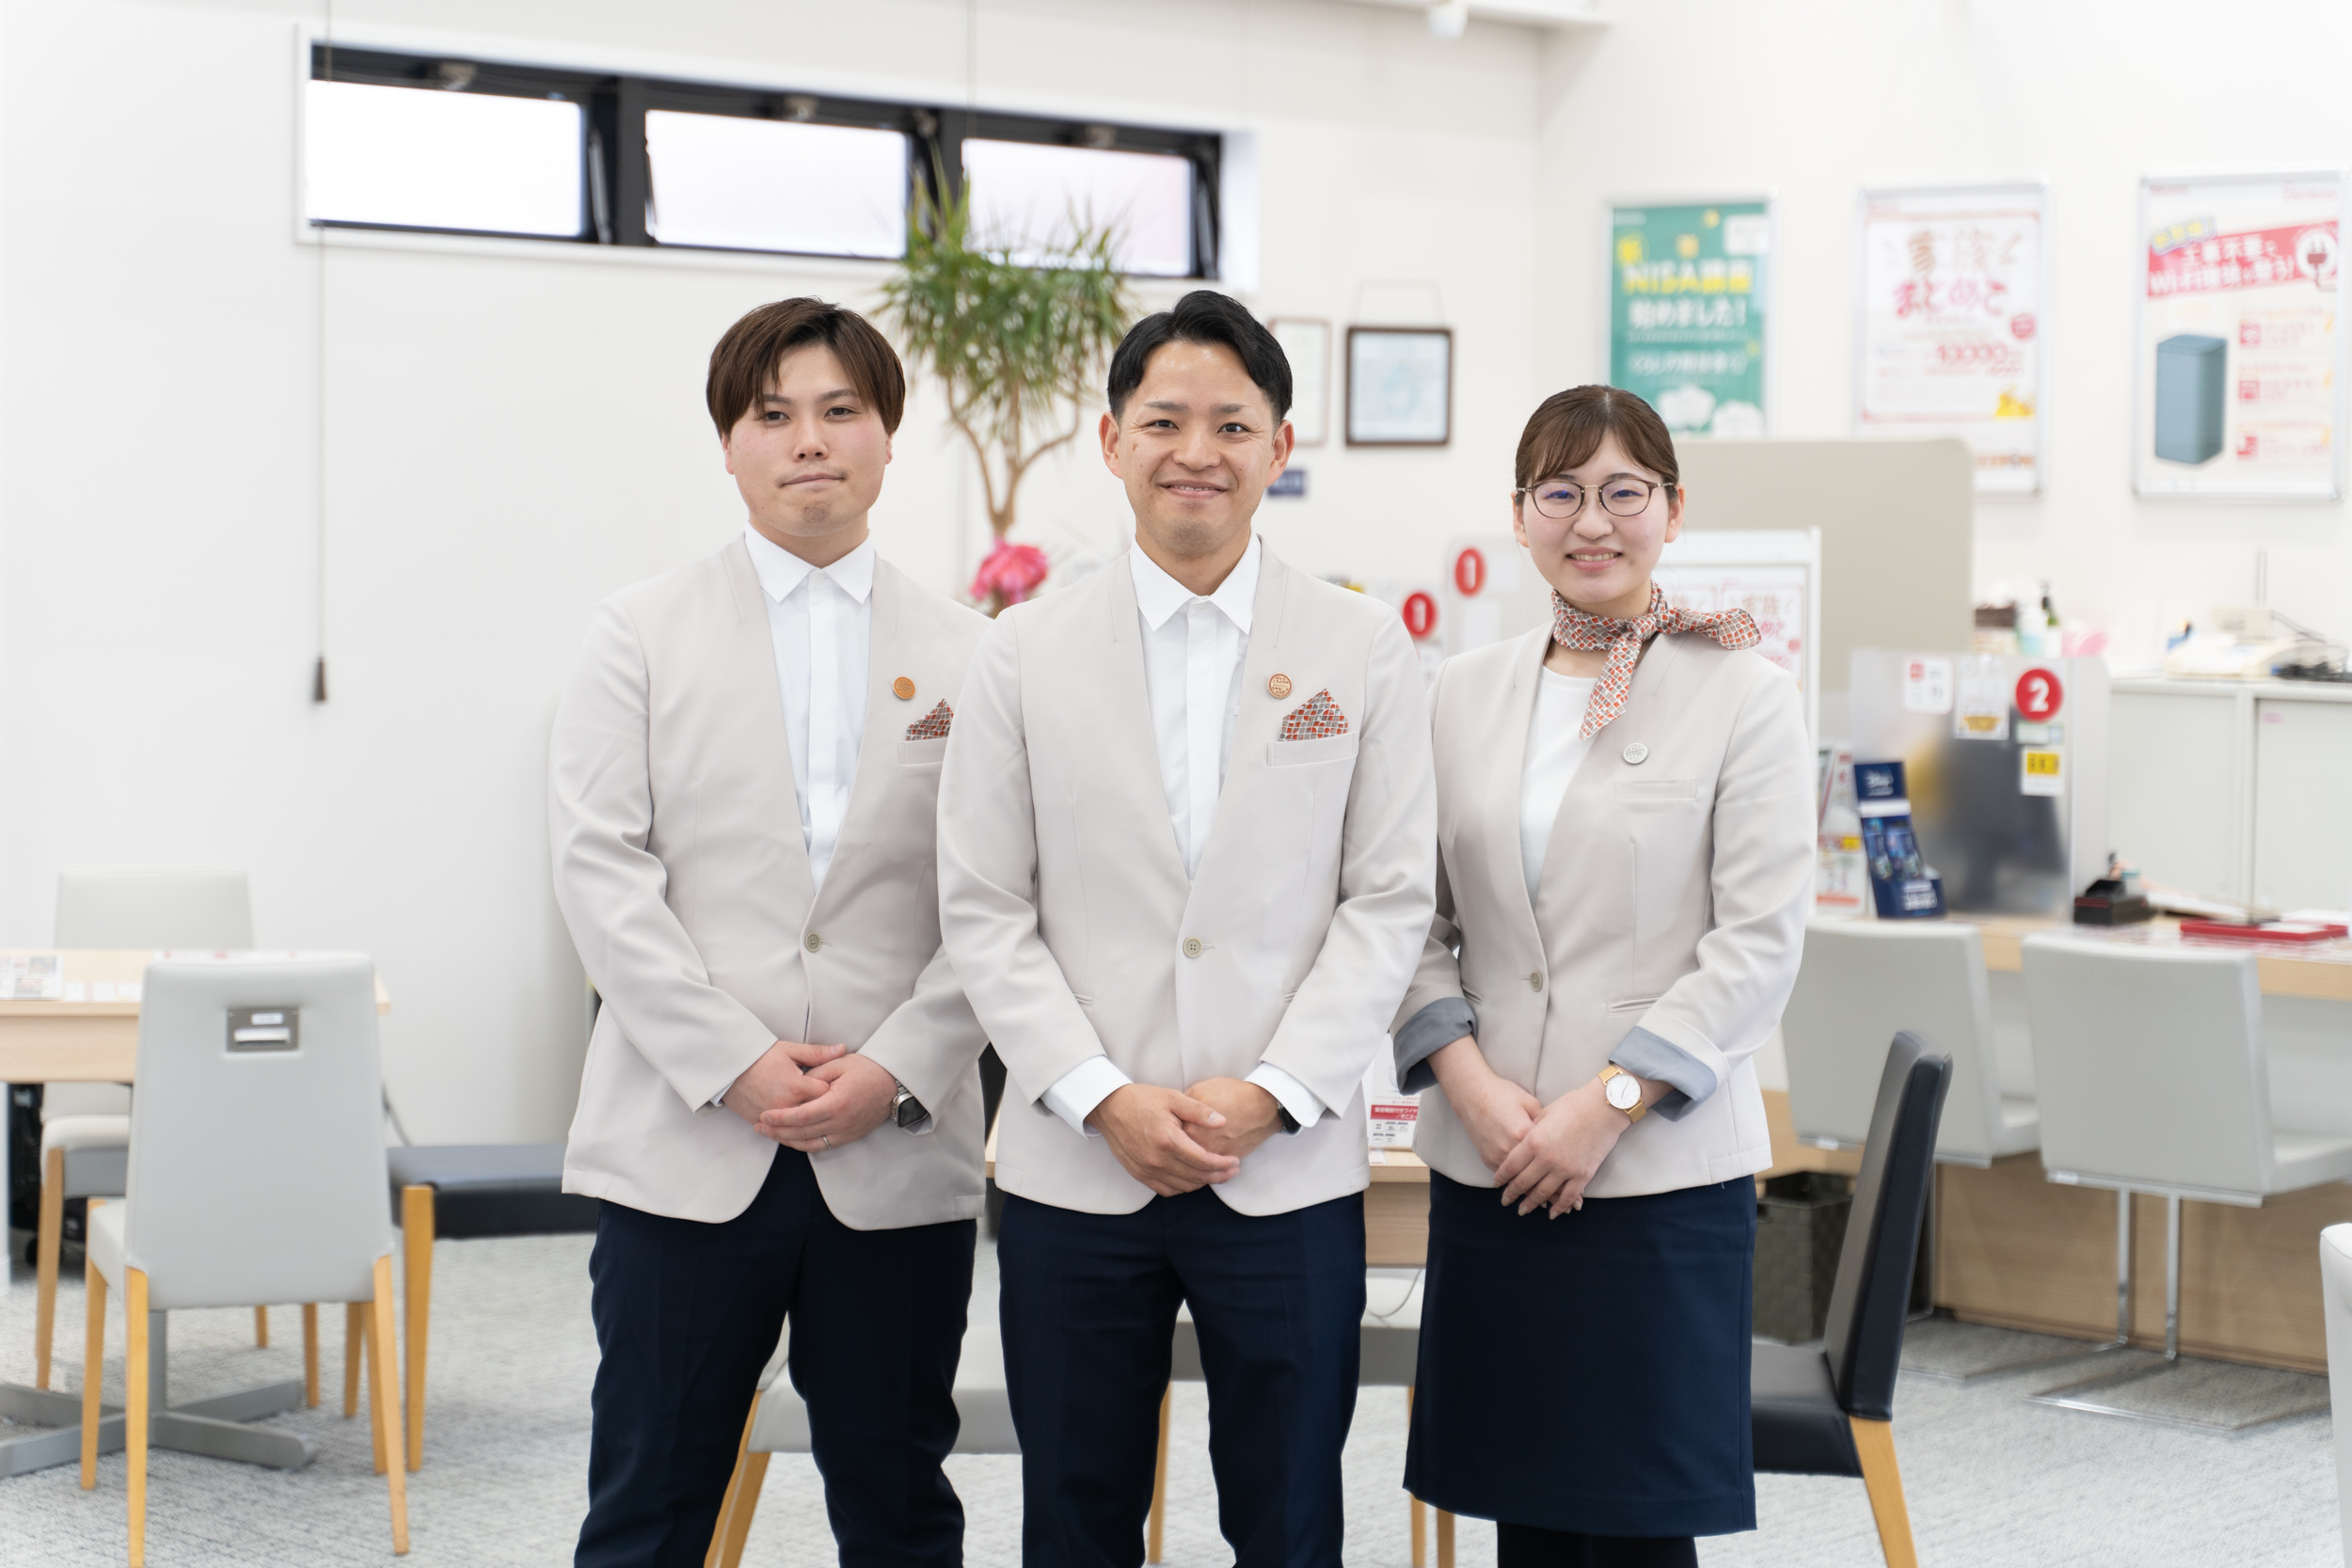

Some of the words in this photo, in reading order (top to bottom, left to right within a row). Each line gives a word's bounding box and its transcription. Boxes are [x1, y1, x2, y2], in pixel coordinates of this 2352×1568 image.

[1463, 554, 1476, 591] 1
[1413, 598, 1426, 632] 1
[2029, 676, 2050, 712] 2
